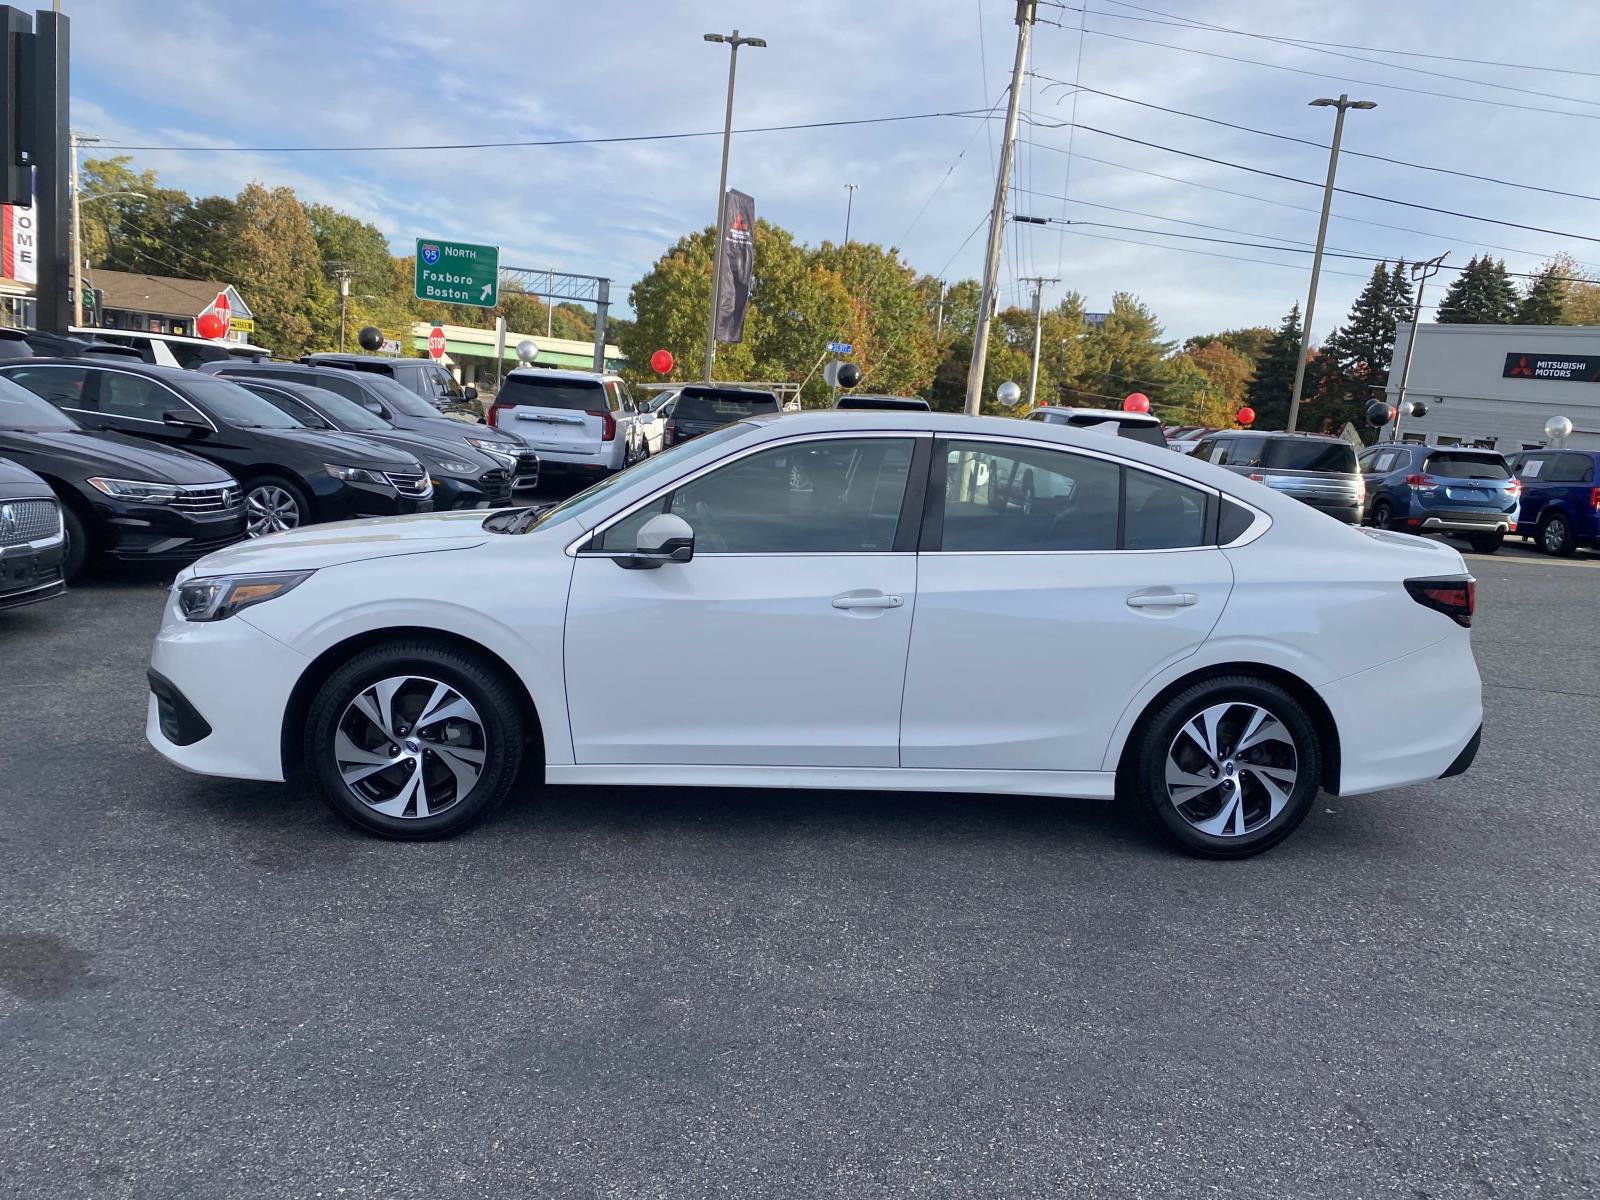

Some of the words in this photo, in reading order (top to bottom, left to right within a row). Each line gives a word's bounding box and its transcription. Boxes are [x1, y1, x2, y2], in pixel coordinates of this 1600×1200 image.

[424, 250, 437, 260] 95
[444, 246, 476, 259] NORTH
[423, 270, 473, 285] Foxboro
[426, 285, 469, 300] Boston
[430, 337, 445, 349] STOP
[1536, 361, 1586, 370] MITSUBISHI
[1535, 369, 1571, 377] MOTORS
